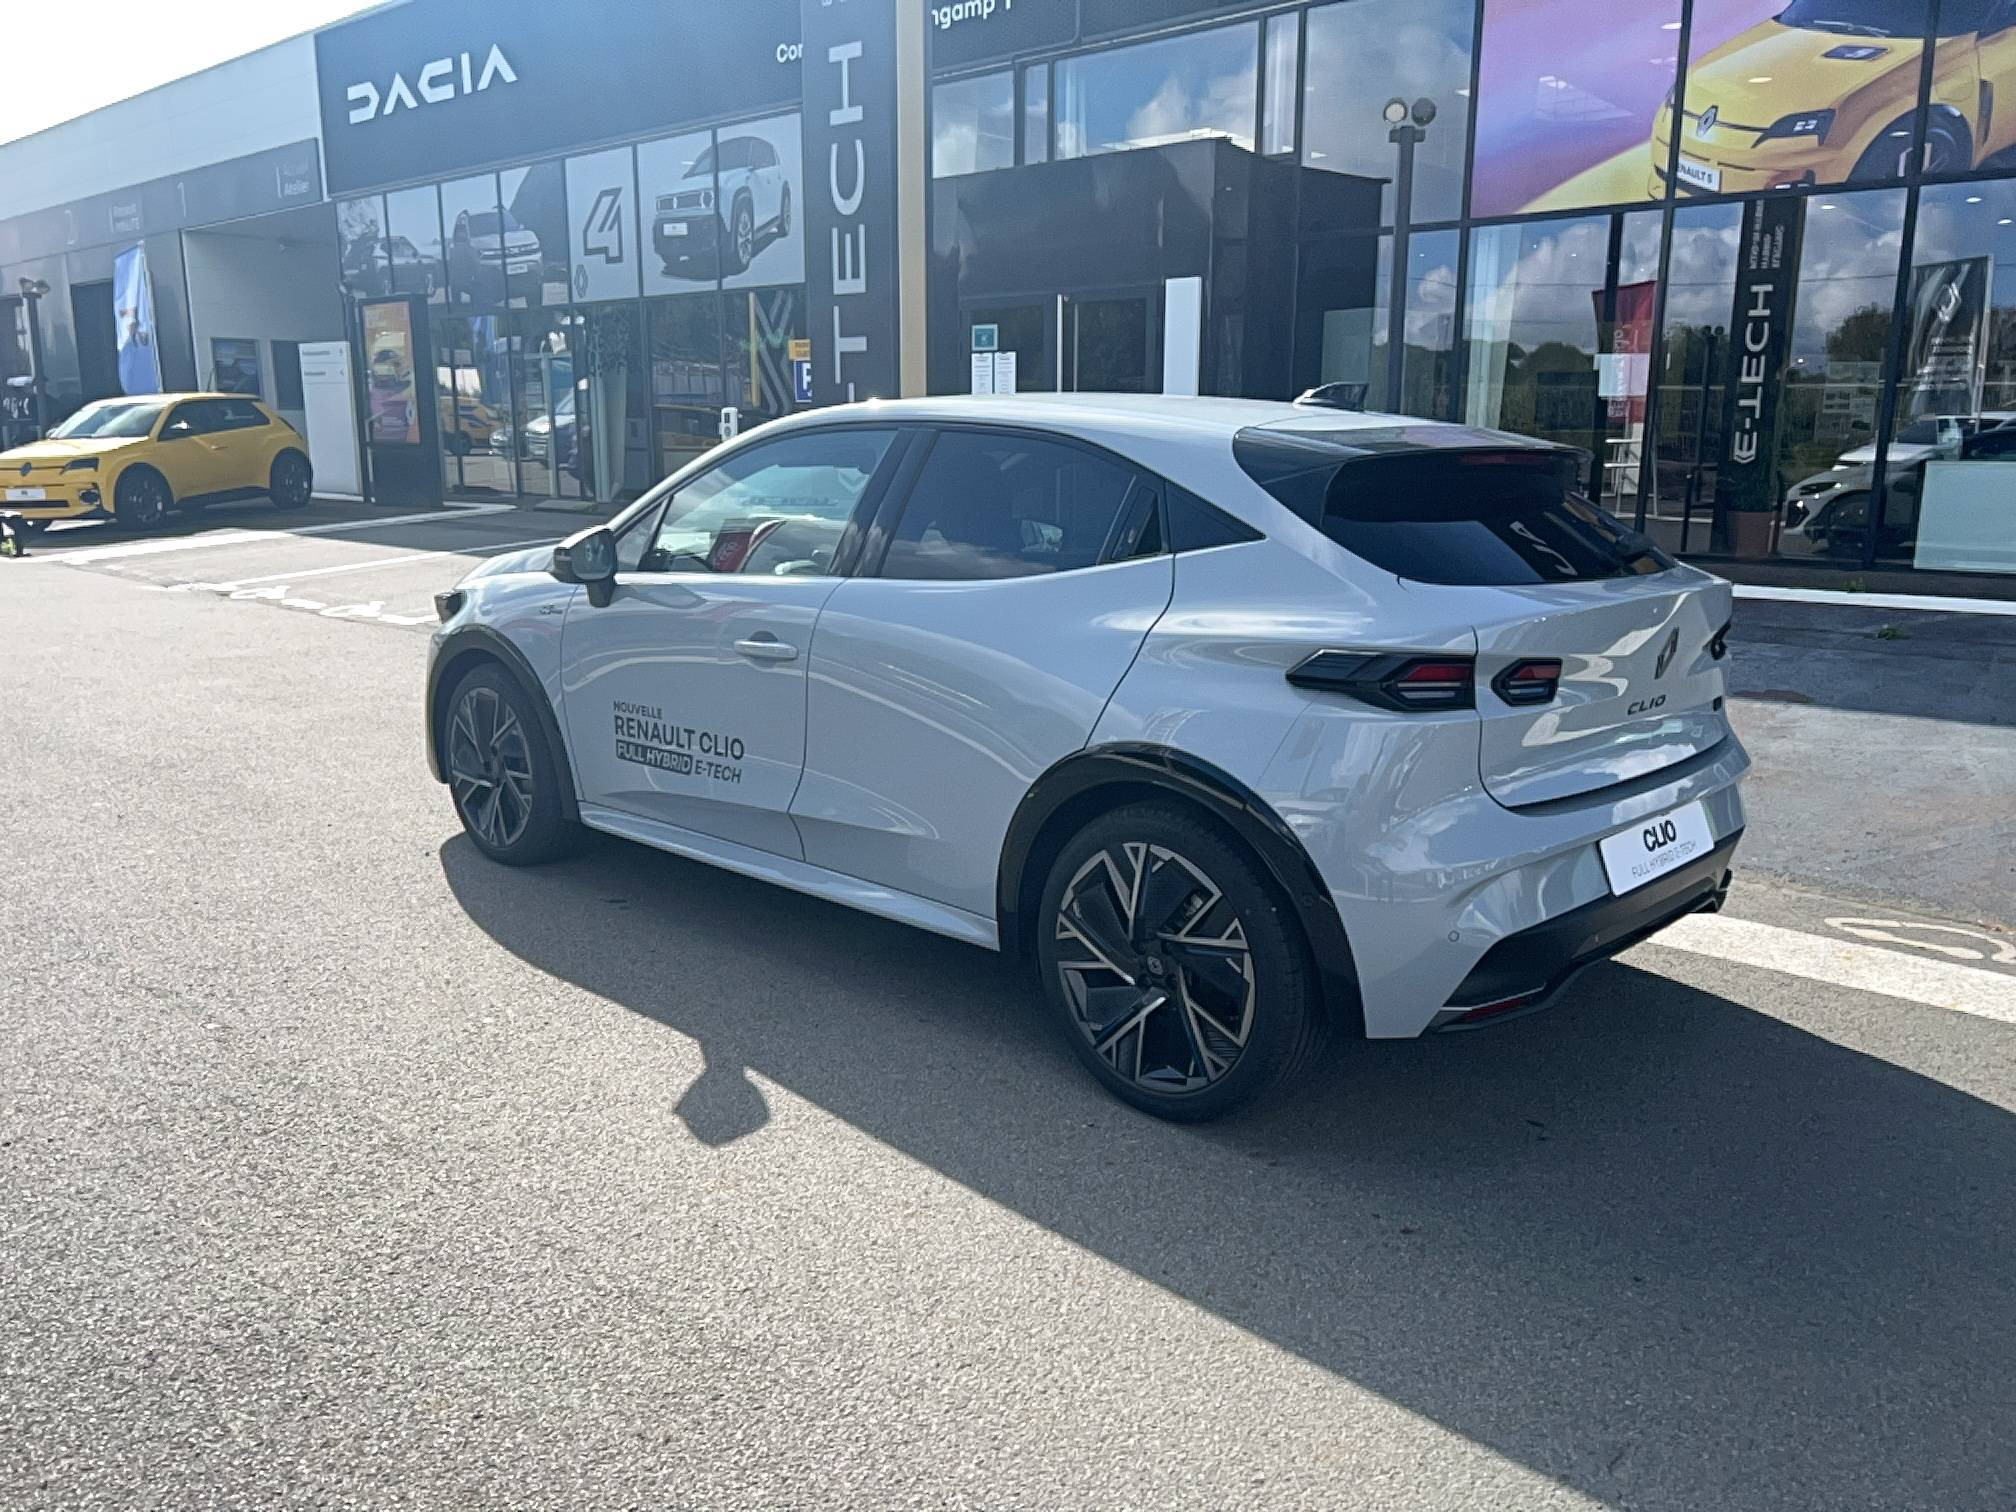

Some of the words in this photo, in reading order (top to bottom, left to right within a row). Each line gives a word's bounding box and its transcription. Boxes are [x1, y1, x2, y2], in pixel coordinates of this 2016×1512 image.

[346, 43, 518, 126] DACIA
[613, 702, 662, 718] NOUVELLE
[1627, 694, 1666, 716] CLIO
[615, 715, 695, 750] RENAULT
[699, 731, 745, 761] CLIO
[618, 743, 644, 761] FULL
[646, 748, 691, 773] HYBRID
[695, 759, 742, 784] E-TECH
[1642, 819, 1677, 853] CLIO
